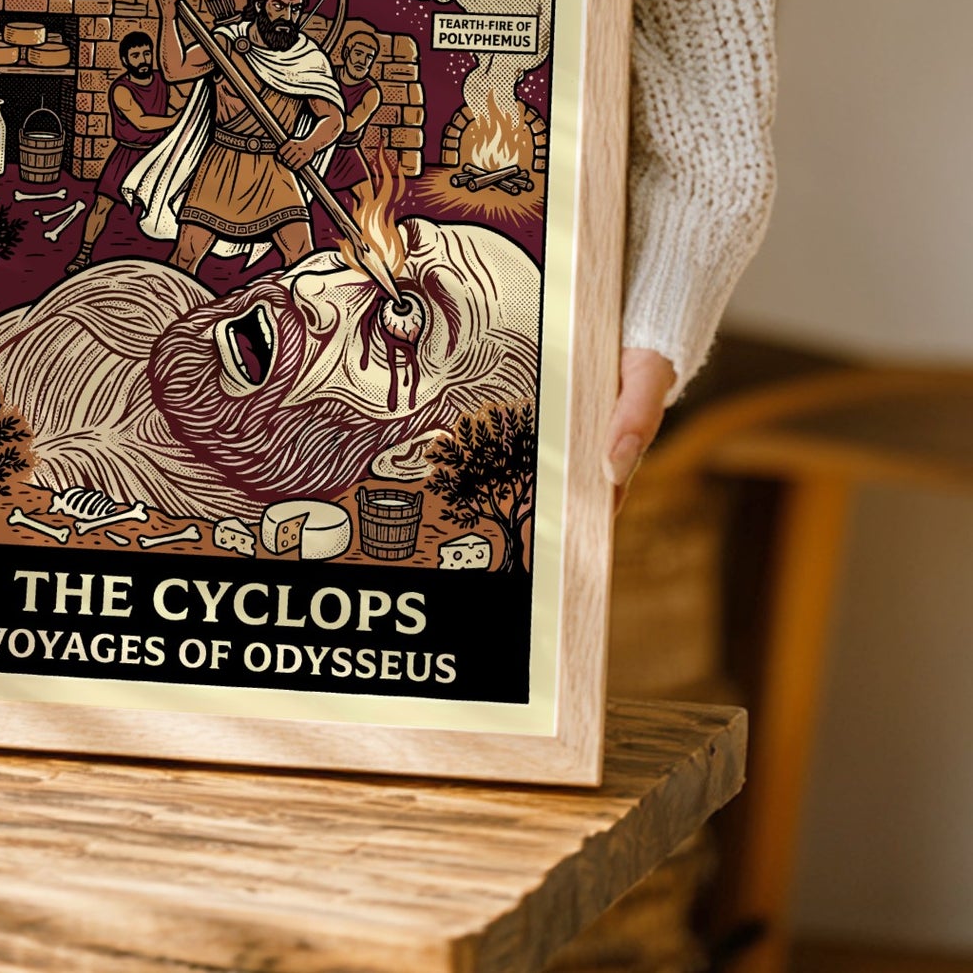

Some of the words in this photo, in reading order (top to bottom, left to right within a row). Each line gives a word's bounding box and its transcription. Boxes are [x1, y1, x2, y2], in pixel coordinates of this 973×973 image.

[438, 32, 531, 48] POLYPHEMUS
[439, 18, 514, 32] TEARTH-FIRE
[516, 21, 532, 32] OF
[13, 570, 133, 618] THE
[152, 578, 427, 635] CYCLOPS
[178, 638, 232, 670] OF
[243, 642, 457, 684] ODYSSEUS
